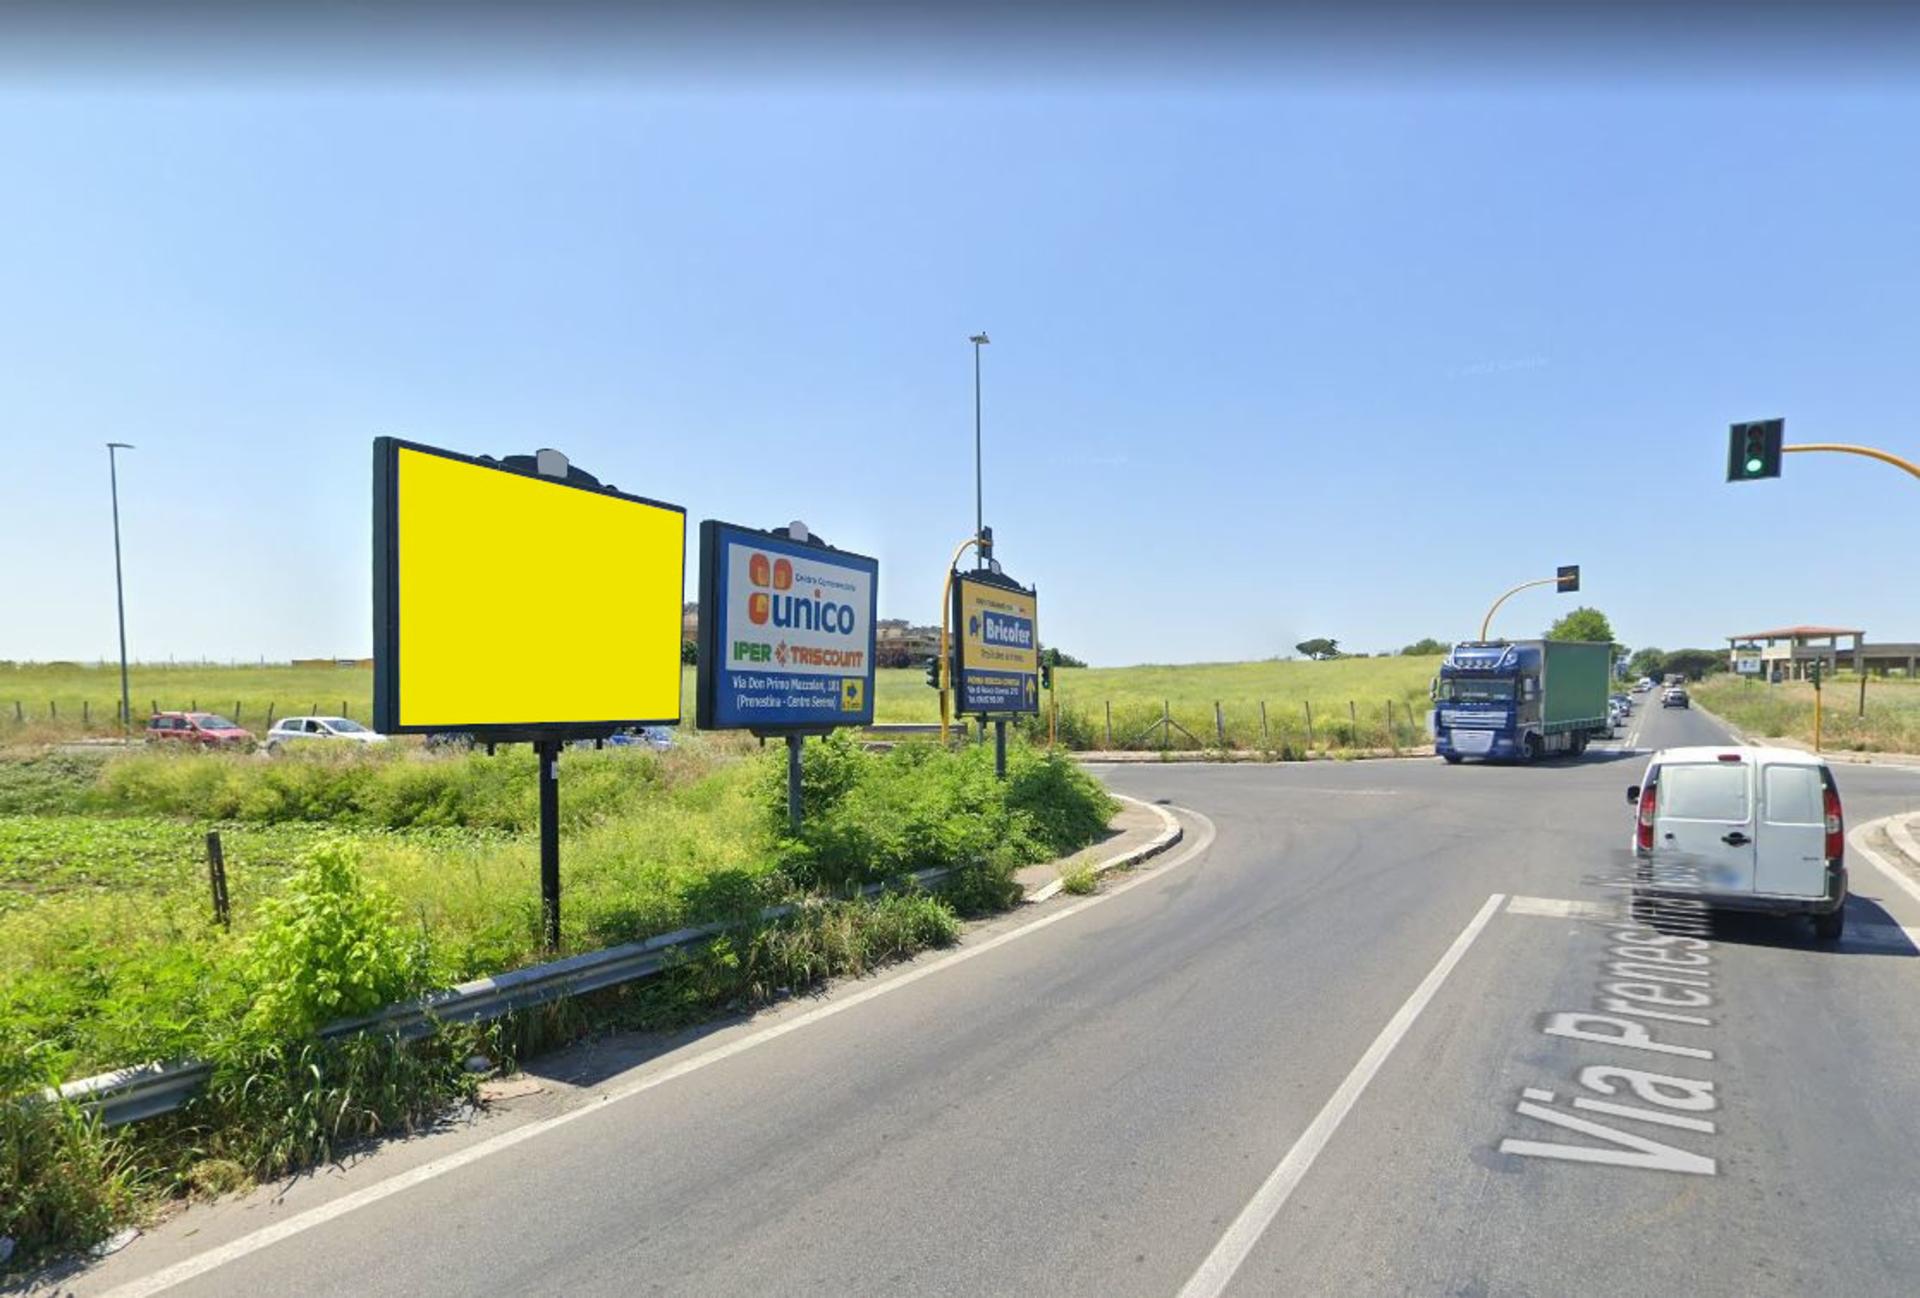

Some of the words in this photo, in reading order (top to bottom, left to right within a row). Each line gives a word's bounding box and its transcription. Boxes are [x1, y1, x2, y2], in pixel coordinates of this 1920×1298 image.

[772, 588, 855, 635] unico
[733, 641, 772, 663] IPER
[791, 645, 864, 668] TRISCOUNT
[732, 676, 747, 690] Via
